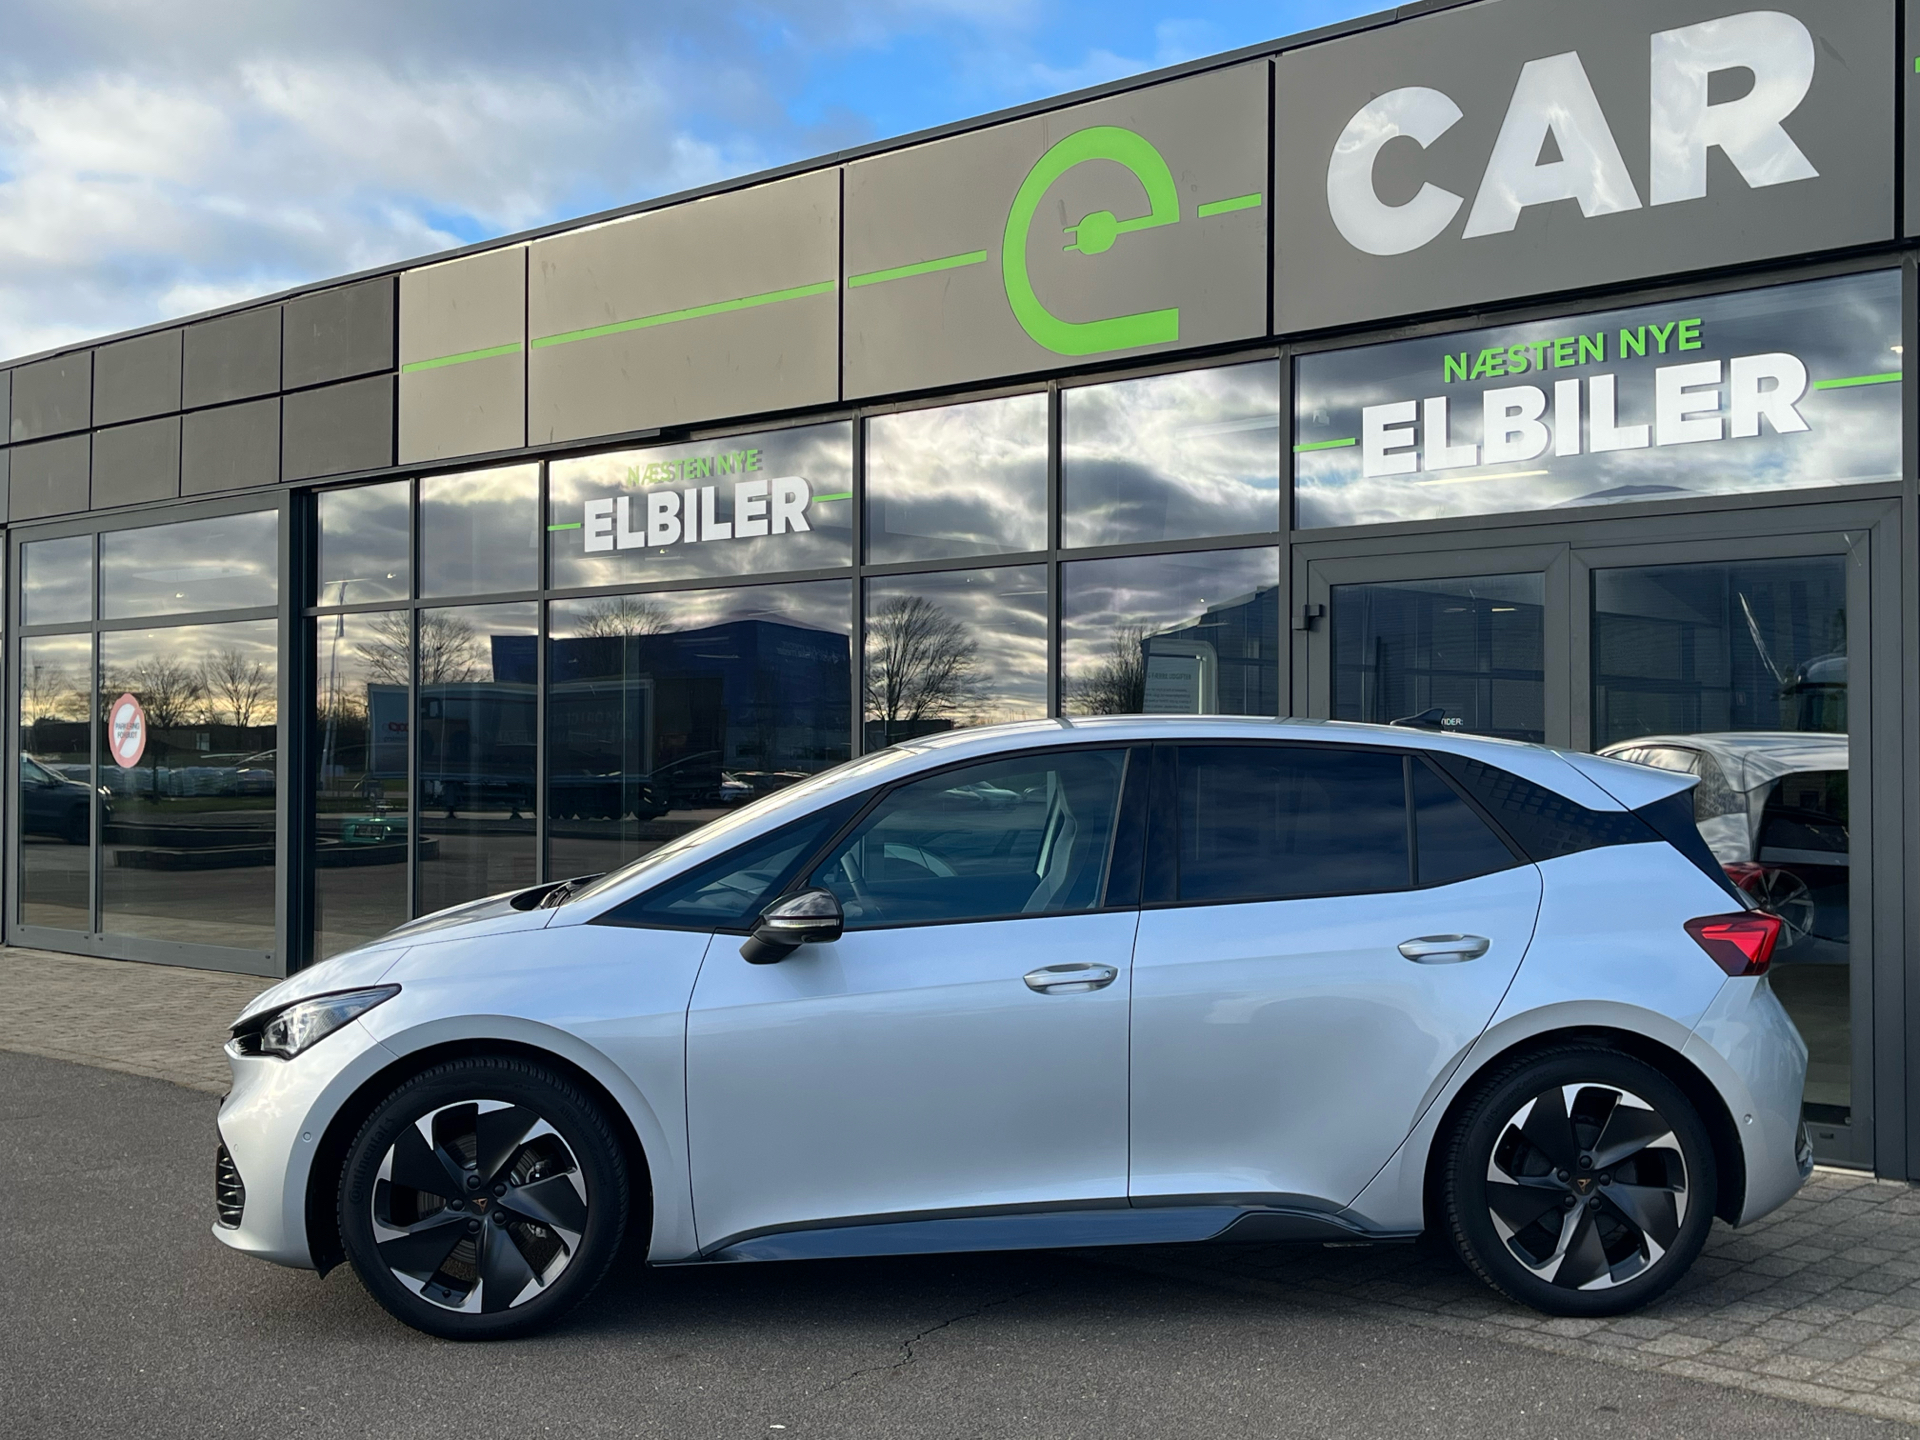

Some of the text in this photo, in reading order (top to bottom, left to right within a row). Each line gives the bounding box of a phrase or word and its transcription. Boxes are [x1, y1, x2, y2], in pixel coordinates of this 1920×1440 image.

[1327, 10, 1819, 256] CAR
[1444, 318, 1704, 382] NÆSTEN NYE
[1362, 352, 1811, 478] ELBILER
[627, 448, 761, 487] NÆSTEN NYE
[584, 476, 811, 552] ELBILER
[115, 722, 140, 731] PARKERING
[348, 1124, 390, 1204] Continental
